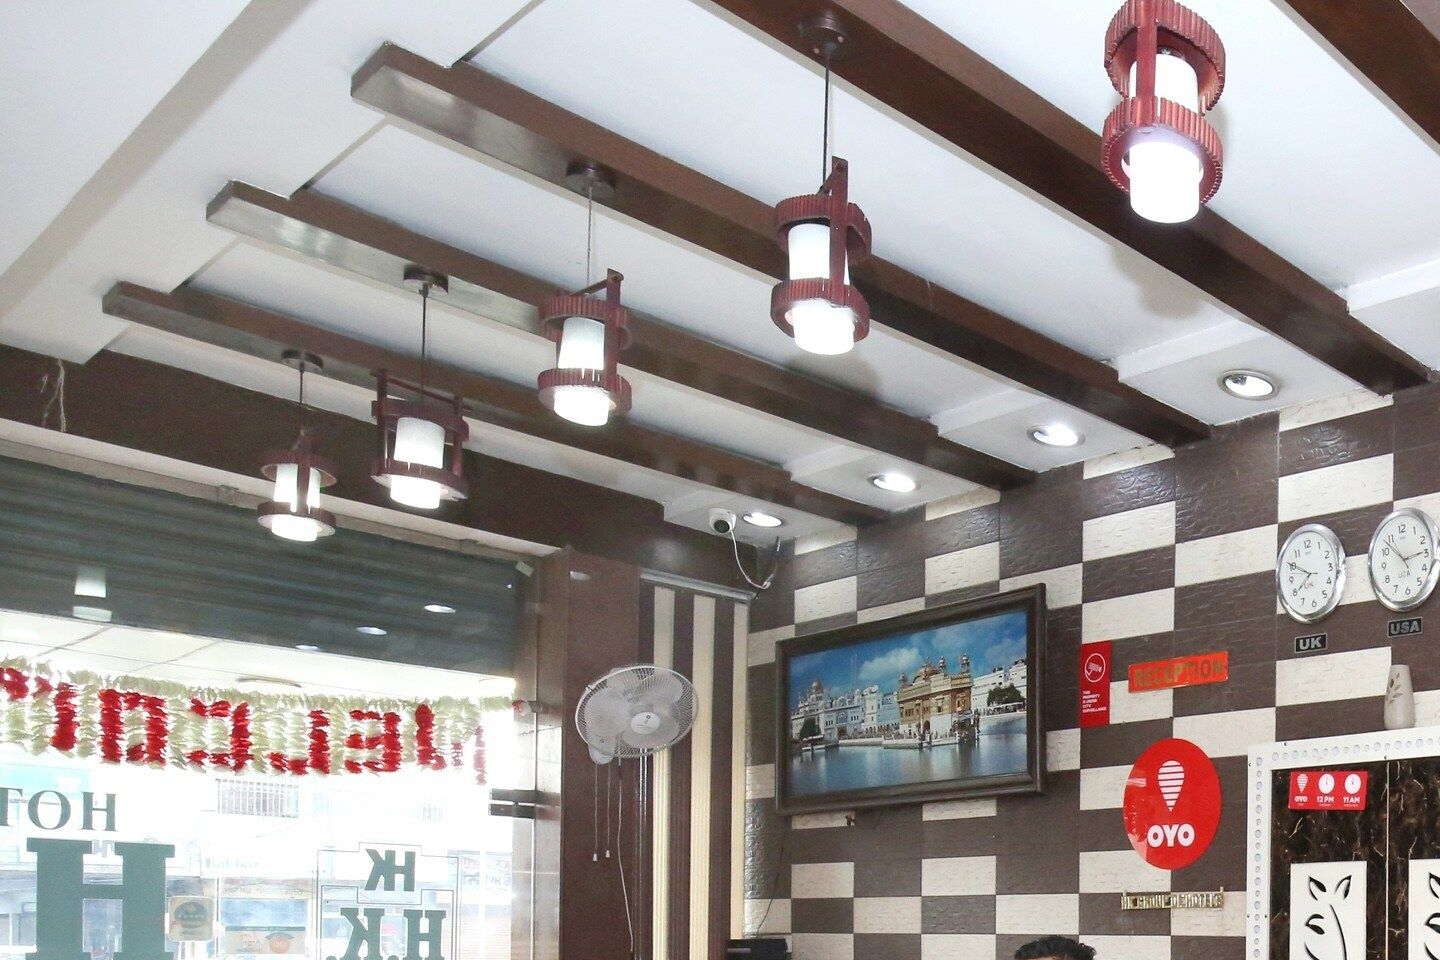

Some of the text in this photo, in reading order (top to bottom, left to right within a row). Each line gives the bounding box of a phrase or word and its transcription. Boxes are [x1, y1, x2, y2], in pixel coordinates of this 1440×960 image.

[1390, 621, 1420, 635] USA
[1299, 636, 1322, 650] UK
[1147, 823, 1195, 848] OYO
